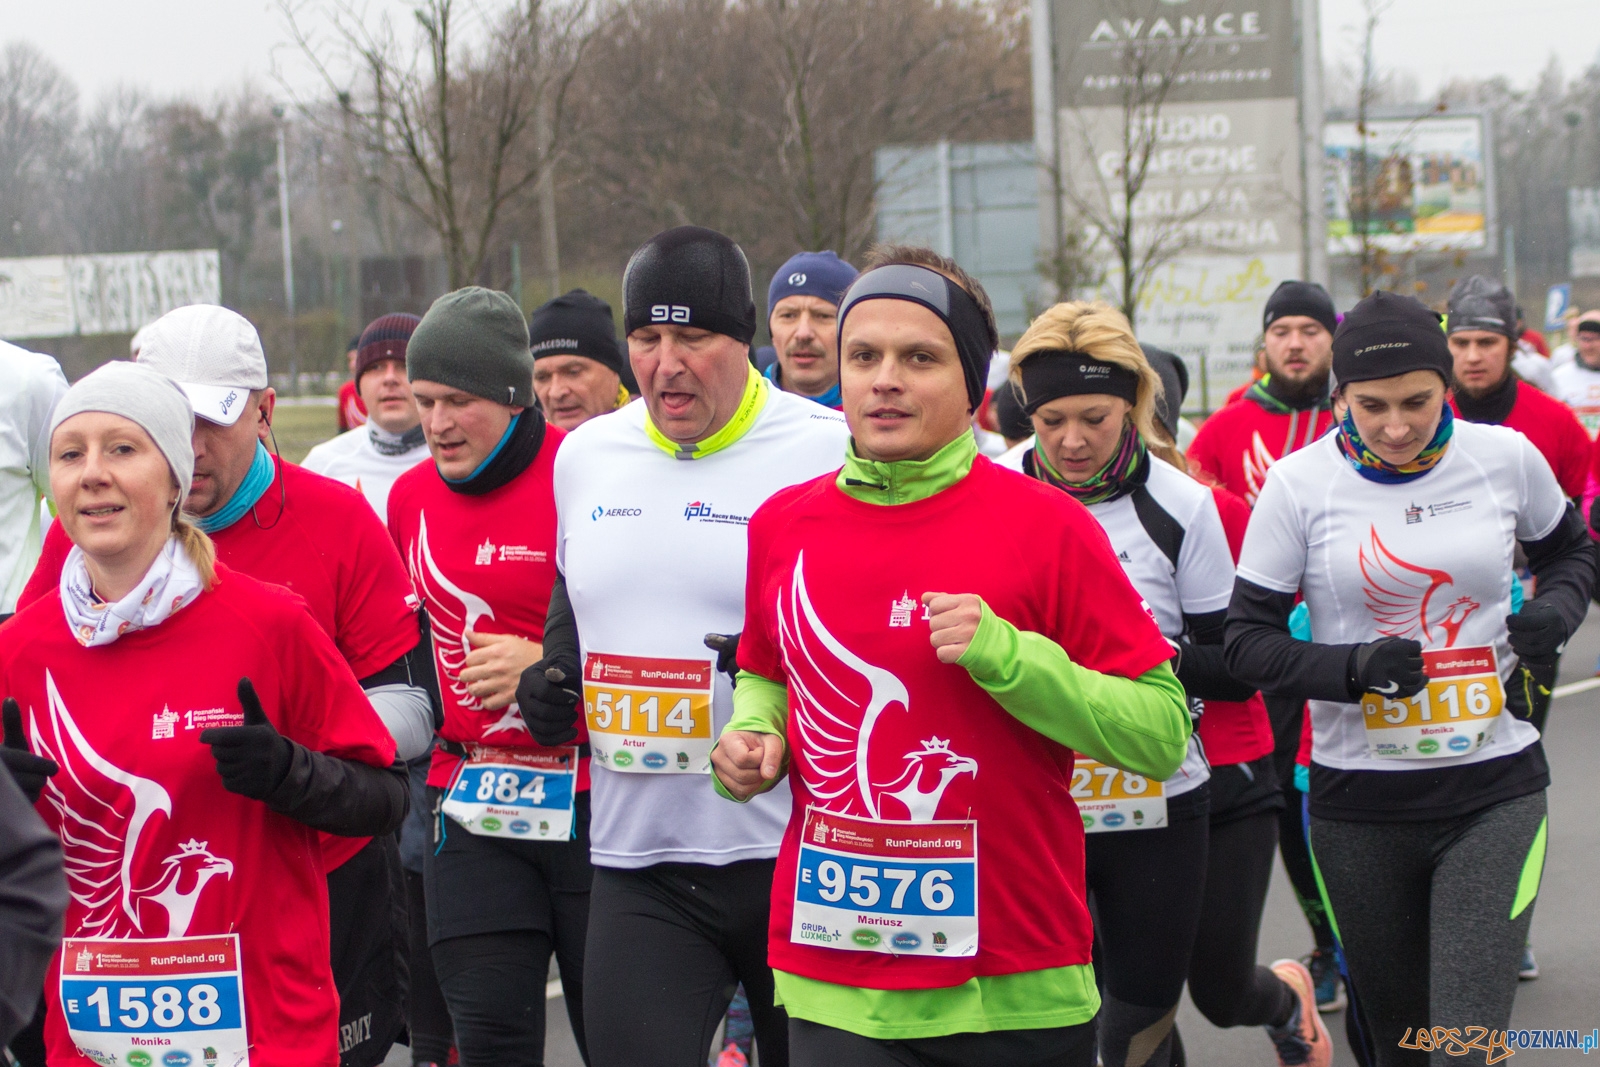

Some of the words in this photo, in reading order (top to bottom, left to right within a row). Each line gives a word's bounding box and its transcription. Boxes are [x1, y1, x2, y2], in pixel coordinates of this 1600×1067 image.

[1089, 11, 1260, 42] AVANCE
[1364, 342, 1410, 353] DUNLOP
[1087, 365, 1111, 374] HI-TEC
[605, 508, 642, 517] AERECO
[1436, 659, 1489, 670] RunPoland.org
[641, 669, 701, 682] RunPoland.org
[1366, 703, 1377, 715] D
[1382, 682, 1491, 725] 5116
[193, 707, 224, 716] Poznański
[595, 691, 696, 734] 5114
[184, 710, 195, 730] 1
[193, 714, 207, 722] Bieg
[1421, 726, 1454, 736] Monika
[622, 738, 646, 748] Artur
[458, 780, 468, 791] E
[476, 770, 546, 805] 884
[486, 806, 519, 816] Mariusz
[885, 838, 962, 850] RunPoland.org
[801, 867, 812, 884] E
[817, 859, 955, 911] 9576
[858, 915, 903, 927] Mariusz
[801, 922, 827, 934] GRUPA
[800, 931, 832, 942] LUXMED
[151, 953, 225, 966] RunPoland.org
[67, 999, 79, 1013] E
[87, 983, 222, 1028] 1588
[131, 1036, 171, 1046] Monika
